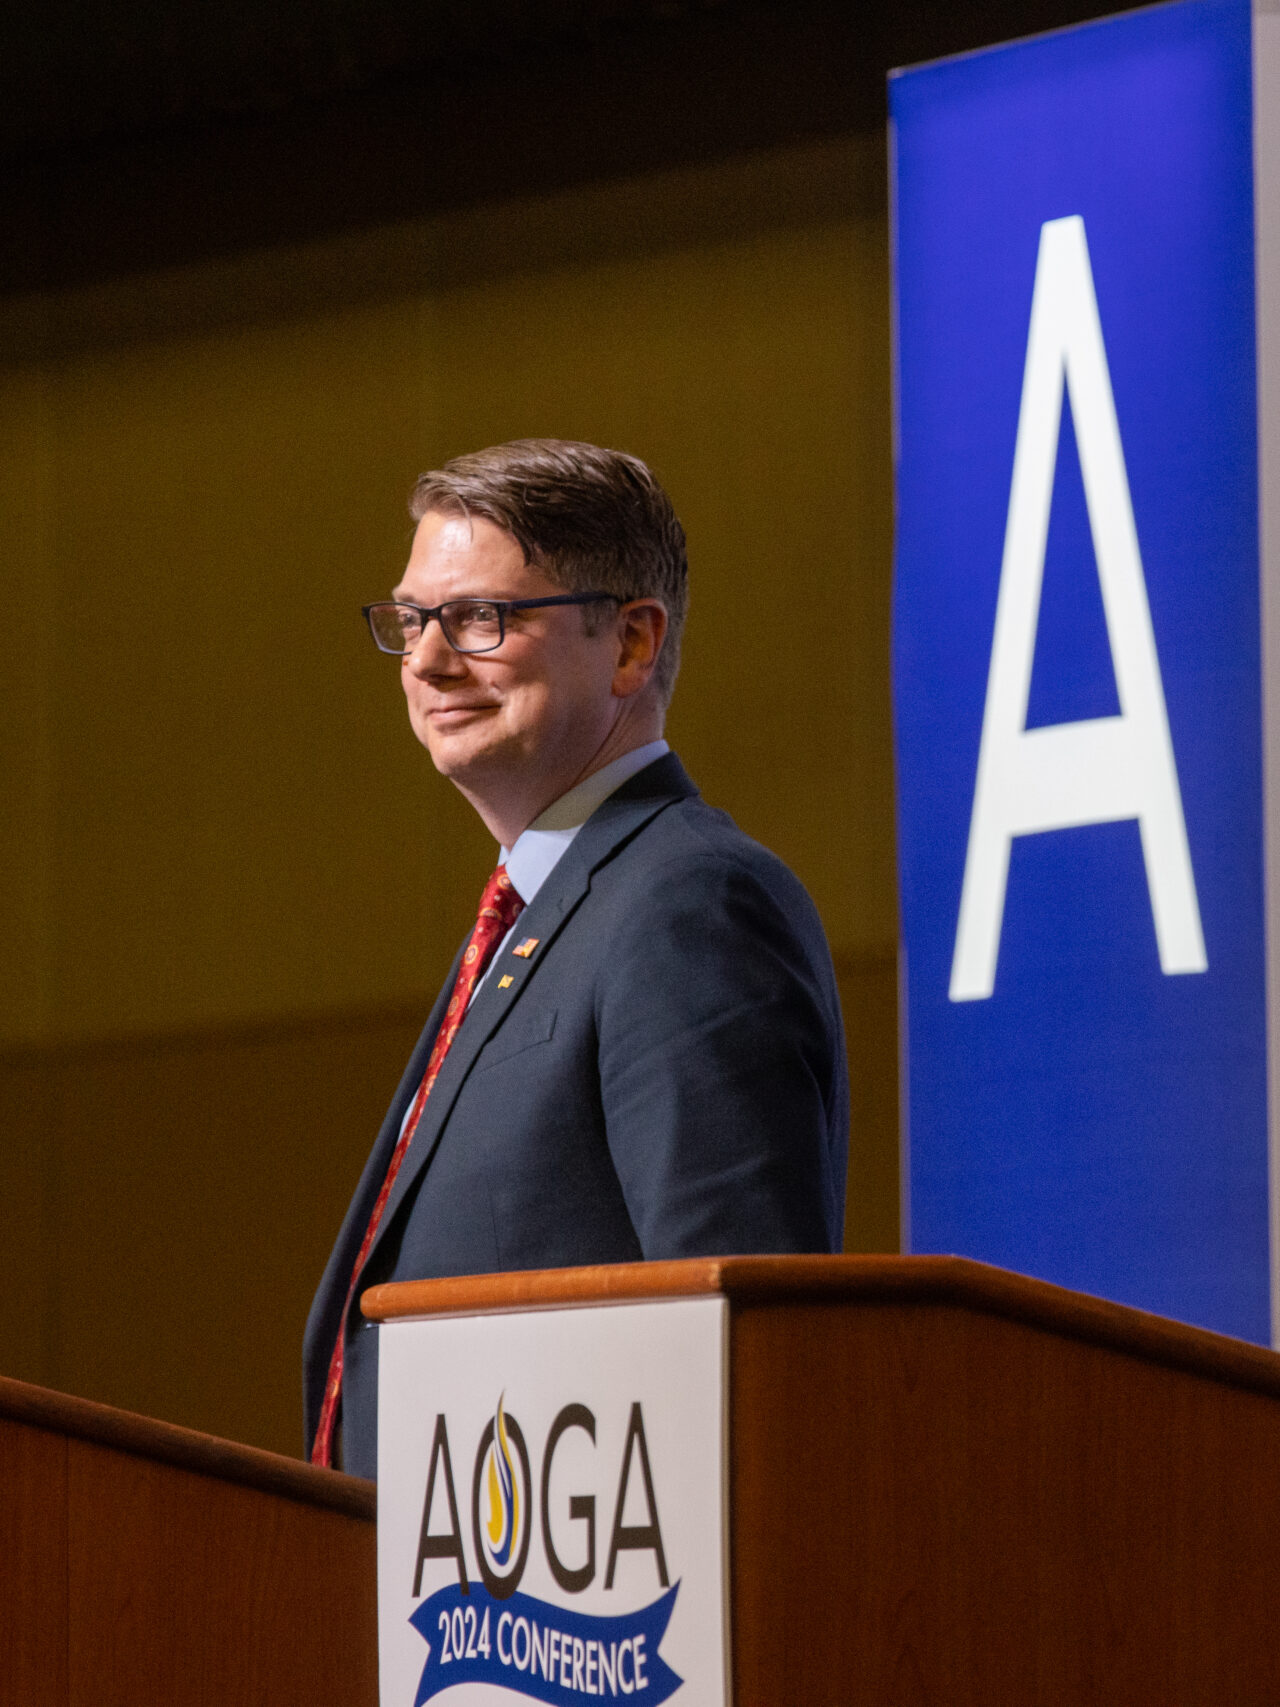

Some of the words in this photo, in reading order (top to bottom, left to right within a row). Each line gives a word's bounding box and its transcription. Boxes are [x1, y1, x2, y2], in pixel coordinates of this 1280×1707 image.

[948, 214, 1208, 1003] A
[411, 1400, 671, 1601] AOGA
[438, 1605, 491, 1665] 2024
[496, 1611, 648, 1697] CONFERENCE
